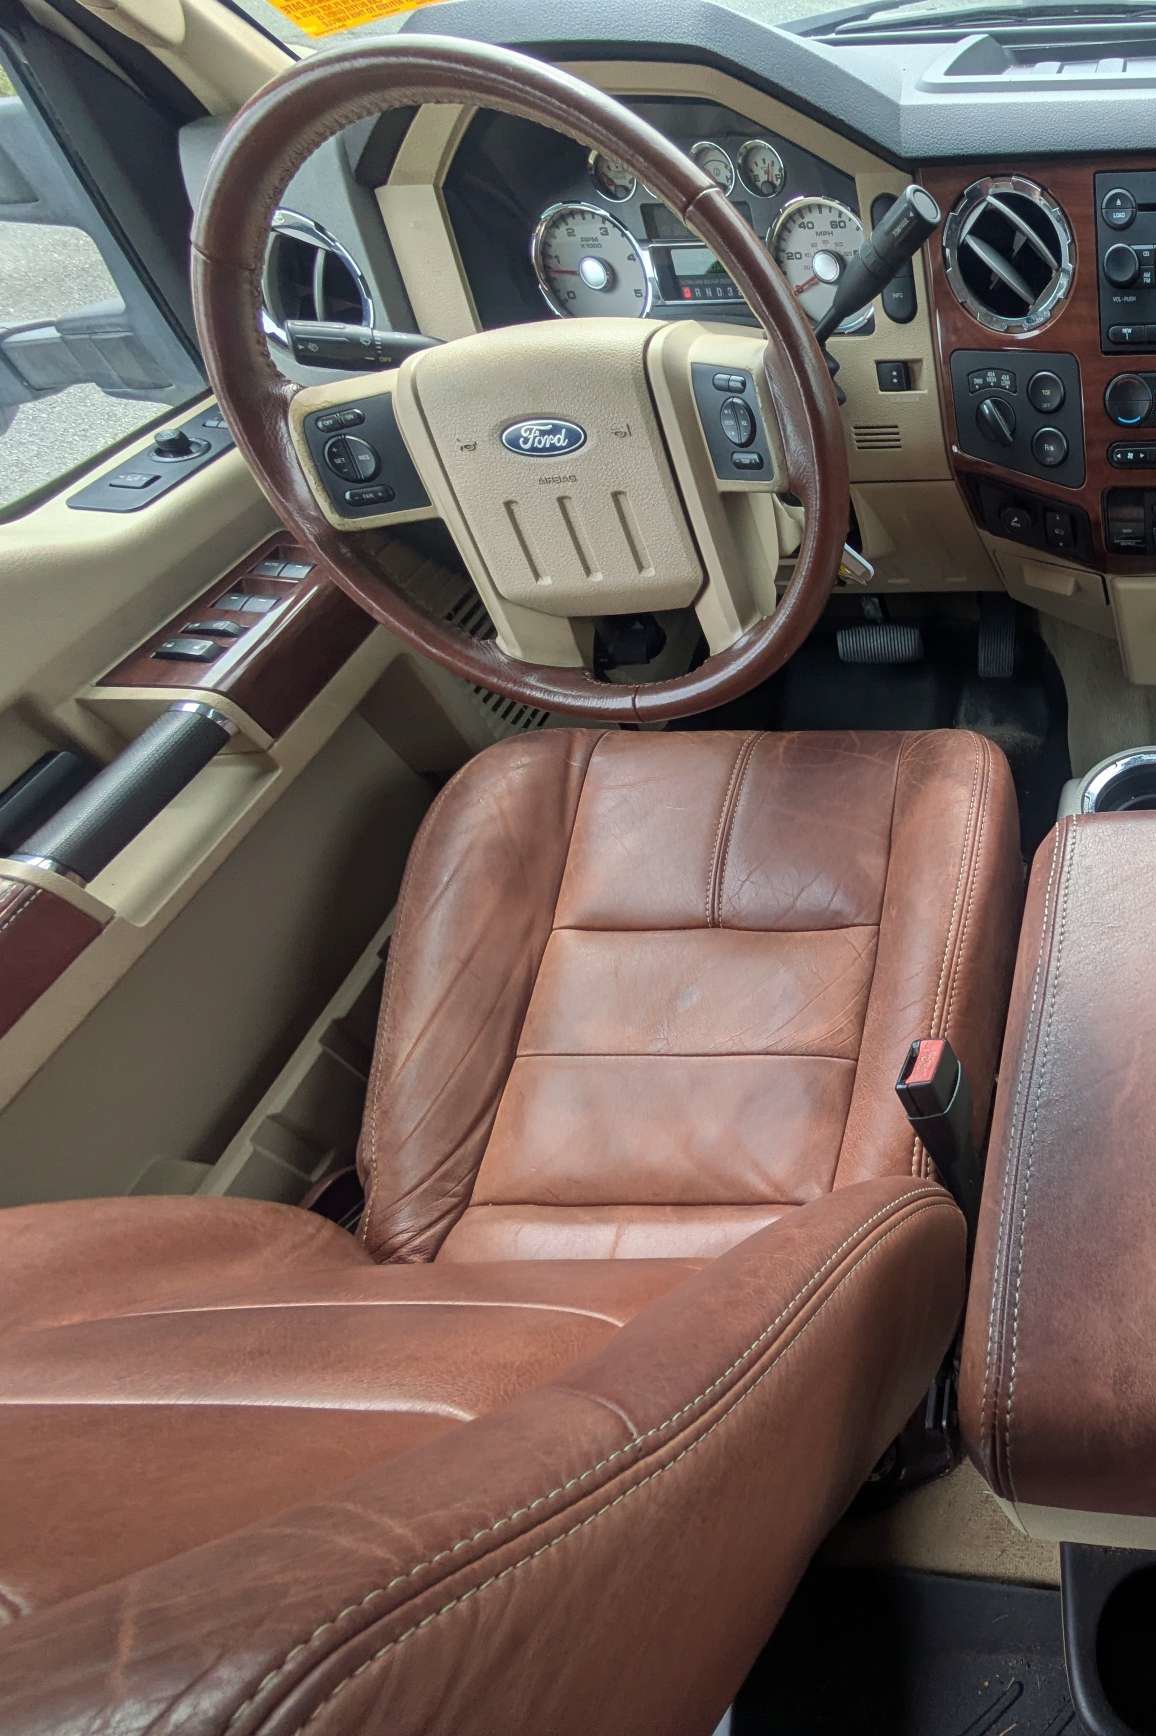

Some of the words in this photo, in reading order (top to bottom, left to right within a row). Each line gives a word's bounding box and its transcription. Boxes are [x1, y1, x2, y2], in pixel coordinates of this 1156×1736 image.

[798, 221, 815, 230] 40
[830, 220, 847, 229] 60
[566, 227, 577, 237] 2
[600, 226, 609, 237] 3
[626, 253, 637, 263] 4
[785, 251, 803, 261] 20
[566, 290, 577, 300] 0
[633, 288, 643, 298] 5
[519, 424, 569, 450] Ford
[538, 474, 578, 486] AIRBAG
